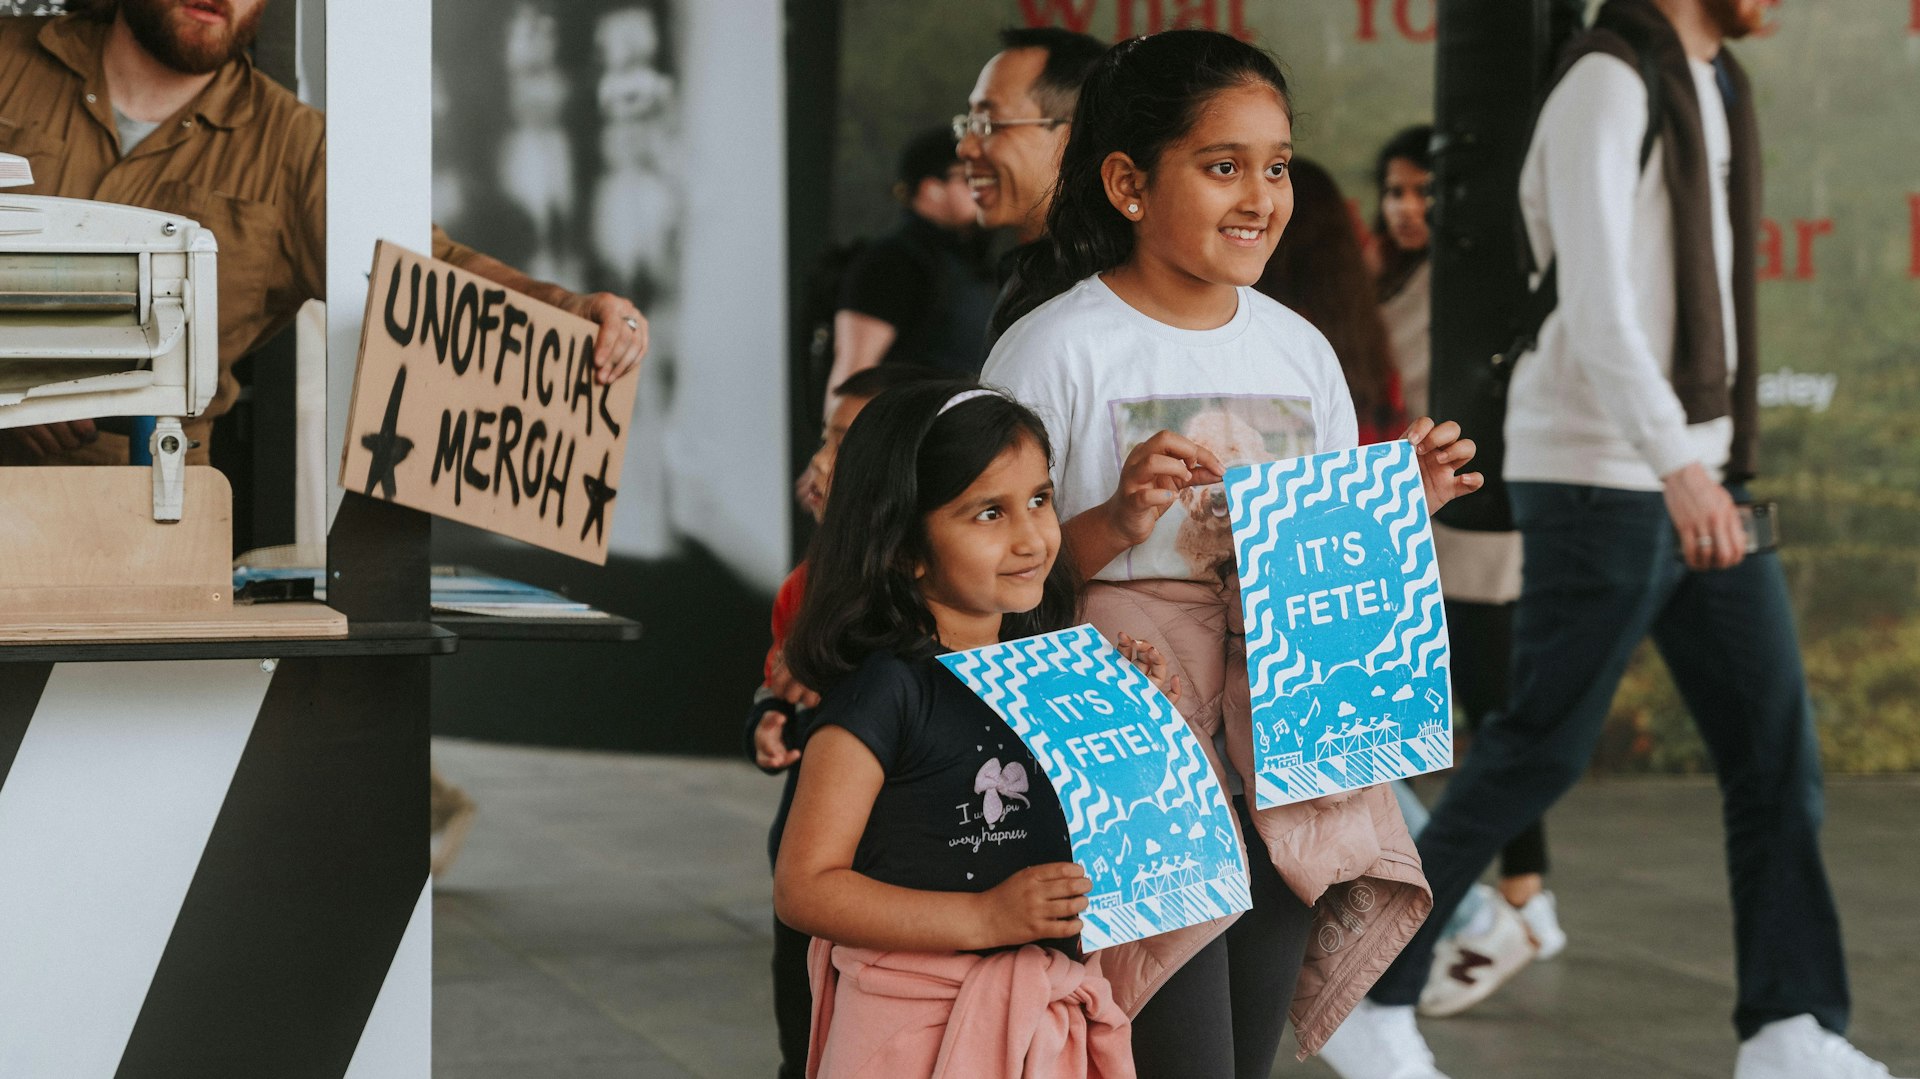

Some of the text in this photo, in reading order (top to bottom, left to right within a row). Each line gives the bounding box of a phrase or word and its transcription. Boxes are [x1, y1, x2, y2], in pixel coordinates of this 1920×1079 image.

[384, 257, 620, 439] UNOFFICIAL
[1296, 531, 1366, 575] IT'S
[1285, 578, 1392, 630] FETE!
[1045, 689, 1114, 724] IT'S
[1065, 723, 1160, 768] FETE!
